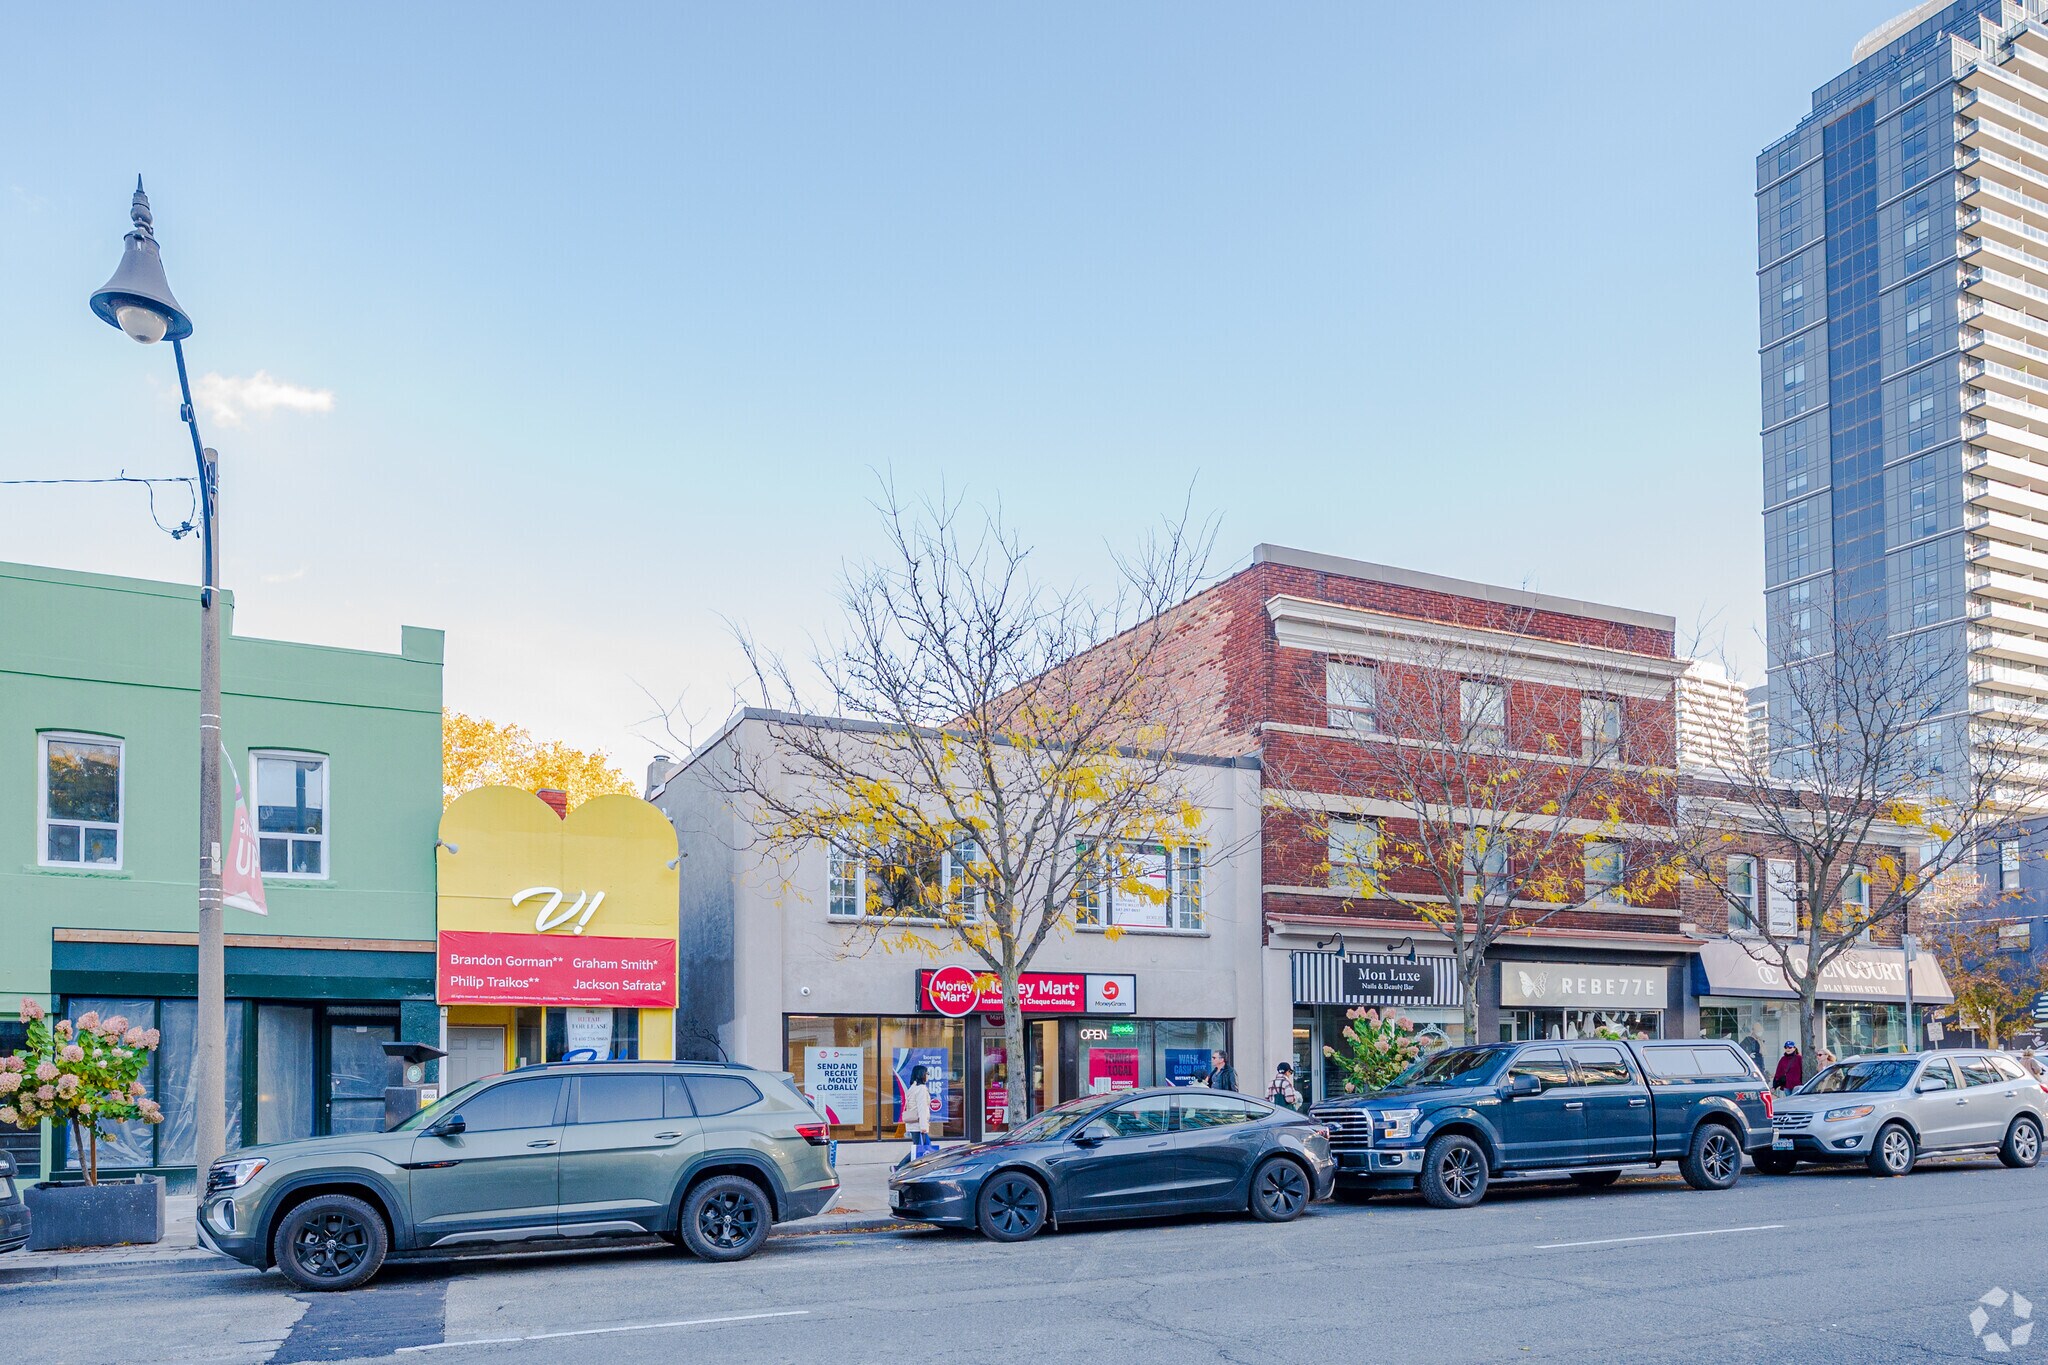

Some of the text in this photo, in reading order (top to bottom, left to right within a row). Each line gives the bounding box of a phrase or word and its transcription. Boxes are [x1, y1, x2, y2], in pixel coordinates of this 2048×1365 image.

[511, 886, 606, 936] V!
[450, 954, 503, 967] Brandon
[572, 957, 618, 970] Graham
[1358, 968, 1421, 982] Mon Luxe
[1794, 957, 1905, 982] OEN COURT
[450, 975, 485, 989] Philip
[572, 978, 620, 990] Jackson
[935, 980, 973, 993] Money
[1384, 983, 1403, 992] Beauty
[1561, 977, 1655, 996] REBE77E
[1823, 984, 1888, 994] PLAY WITH STYLE
[1027, 998, 1050, 1006] Cheque
[1050, 998, 1076, 1006] Cashing
[1080, 1028, 1107, 1040] OPEN
[1104, 1052, 1134, 1065] TRAVEL
[1178, 1054, 1199, 1065] WALK
[1107, 1064, 1134, 1076] LOCAL
[1173, 1064, 1192, 1075] CASH
